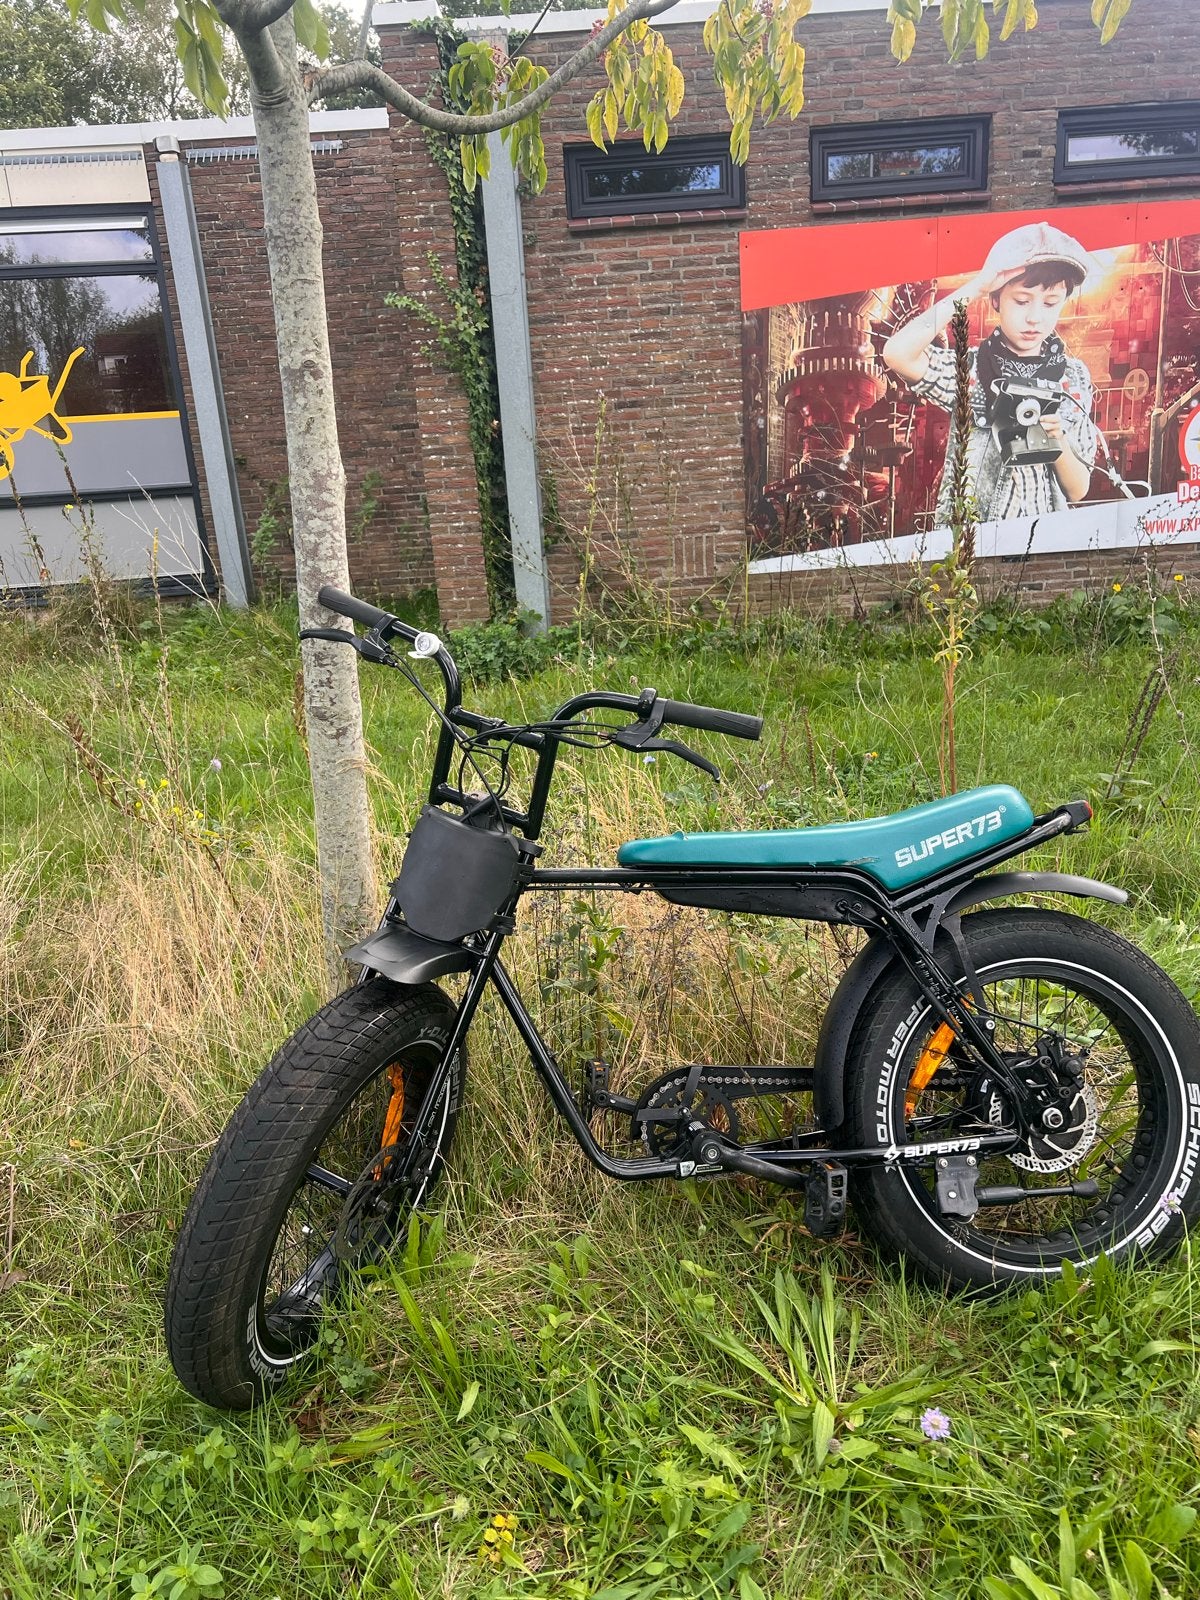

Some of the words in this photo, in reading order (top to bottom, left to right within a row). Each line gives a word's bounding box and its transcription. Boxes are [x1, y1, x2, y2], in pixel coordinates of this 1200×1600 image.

[886, 994, 925, 1059] UPER
[904, 1138, 981, 1158] SUPER73
[246, 1303, 286, 1382] CHWALBE
